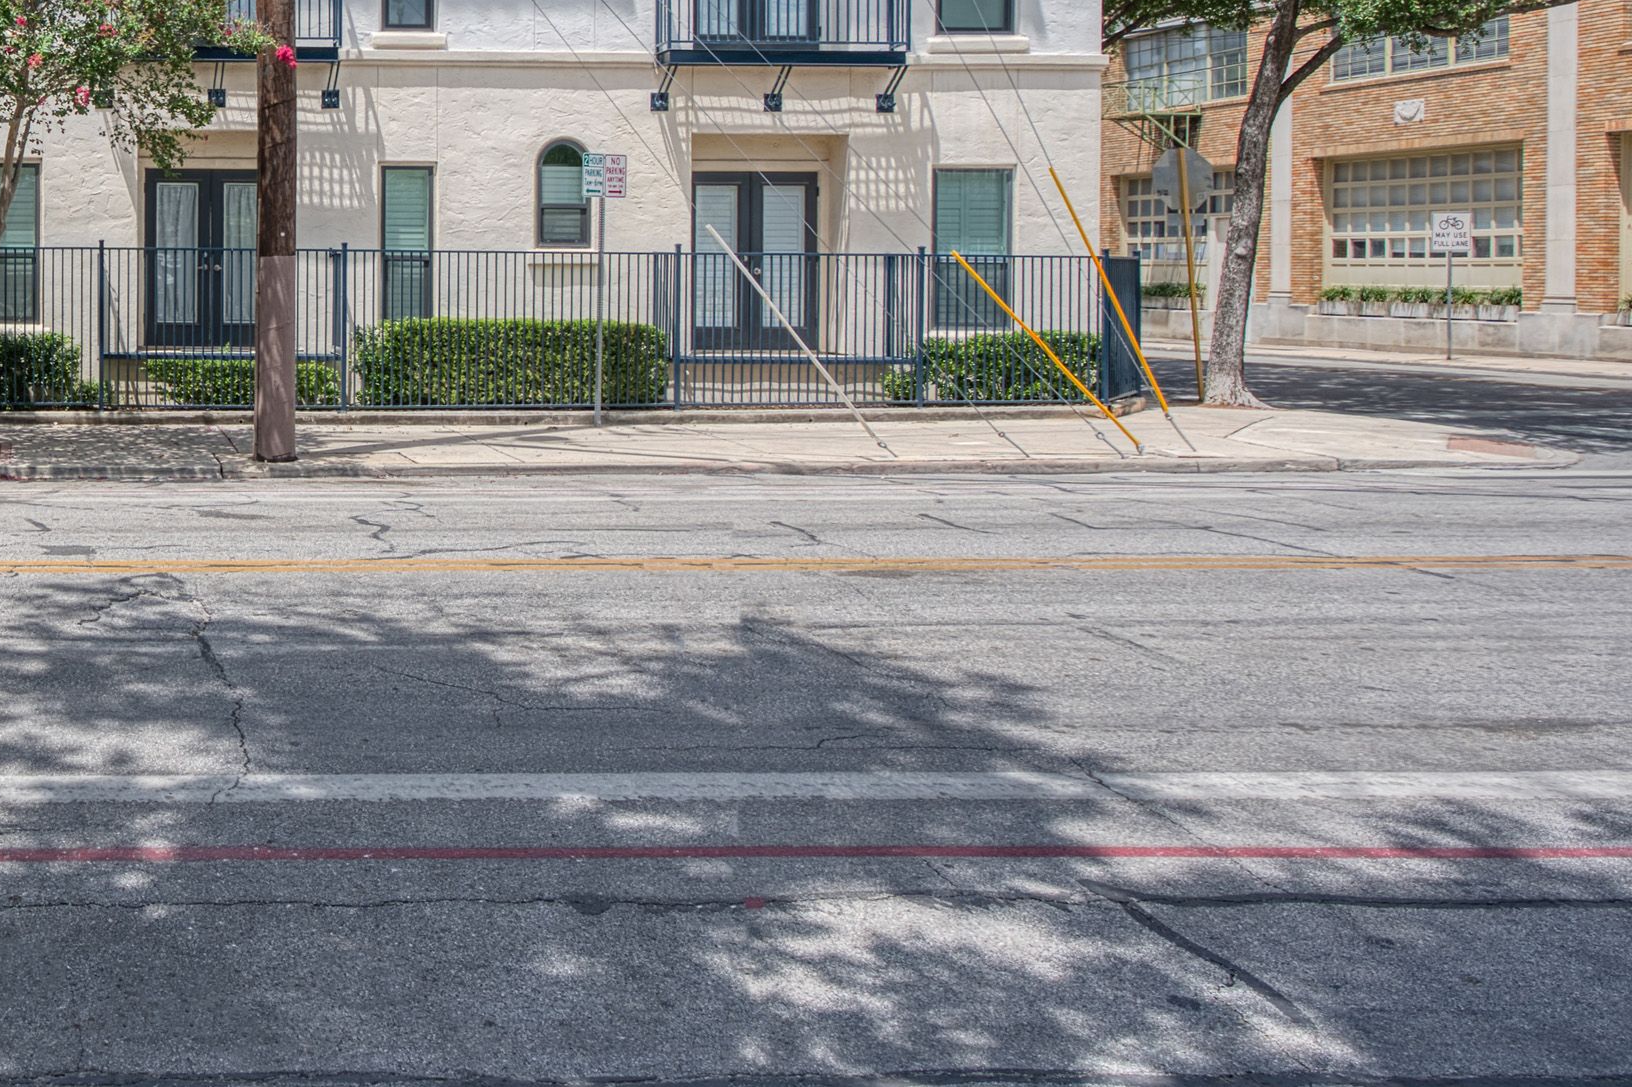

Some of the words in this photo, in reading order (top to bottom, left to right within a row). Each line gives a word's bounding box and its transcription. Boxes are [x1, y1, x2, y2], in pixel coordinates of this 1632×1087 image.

[590, 156, 603, 165] HOUR
[611, 157, 621, 166] NO
[585, 169, 602, 177] PARKING
[606, 167, 625, 175] PARKING
